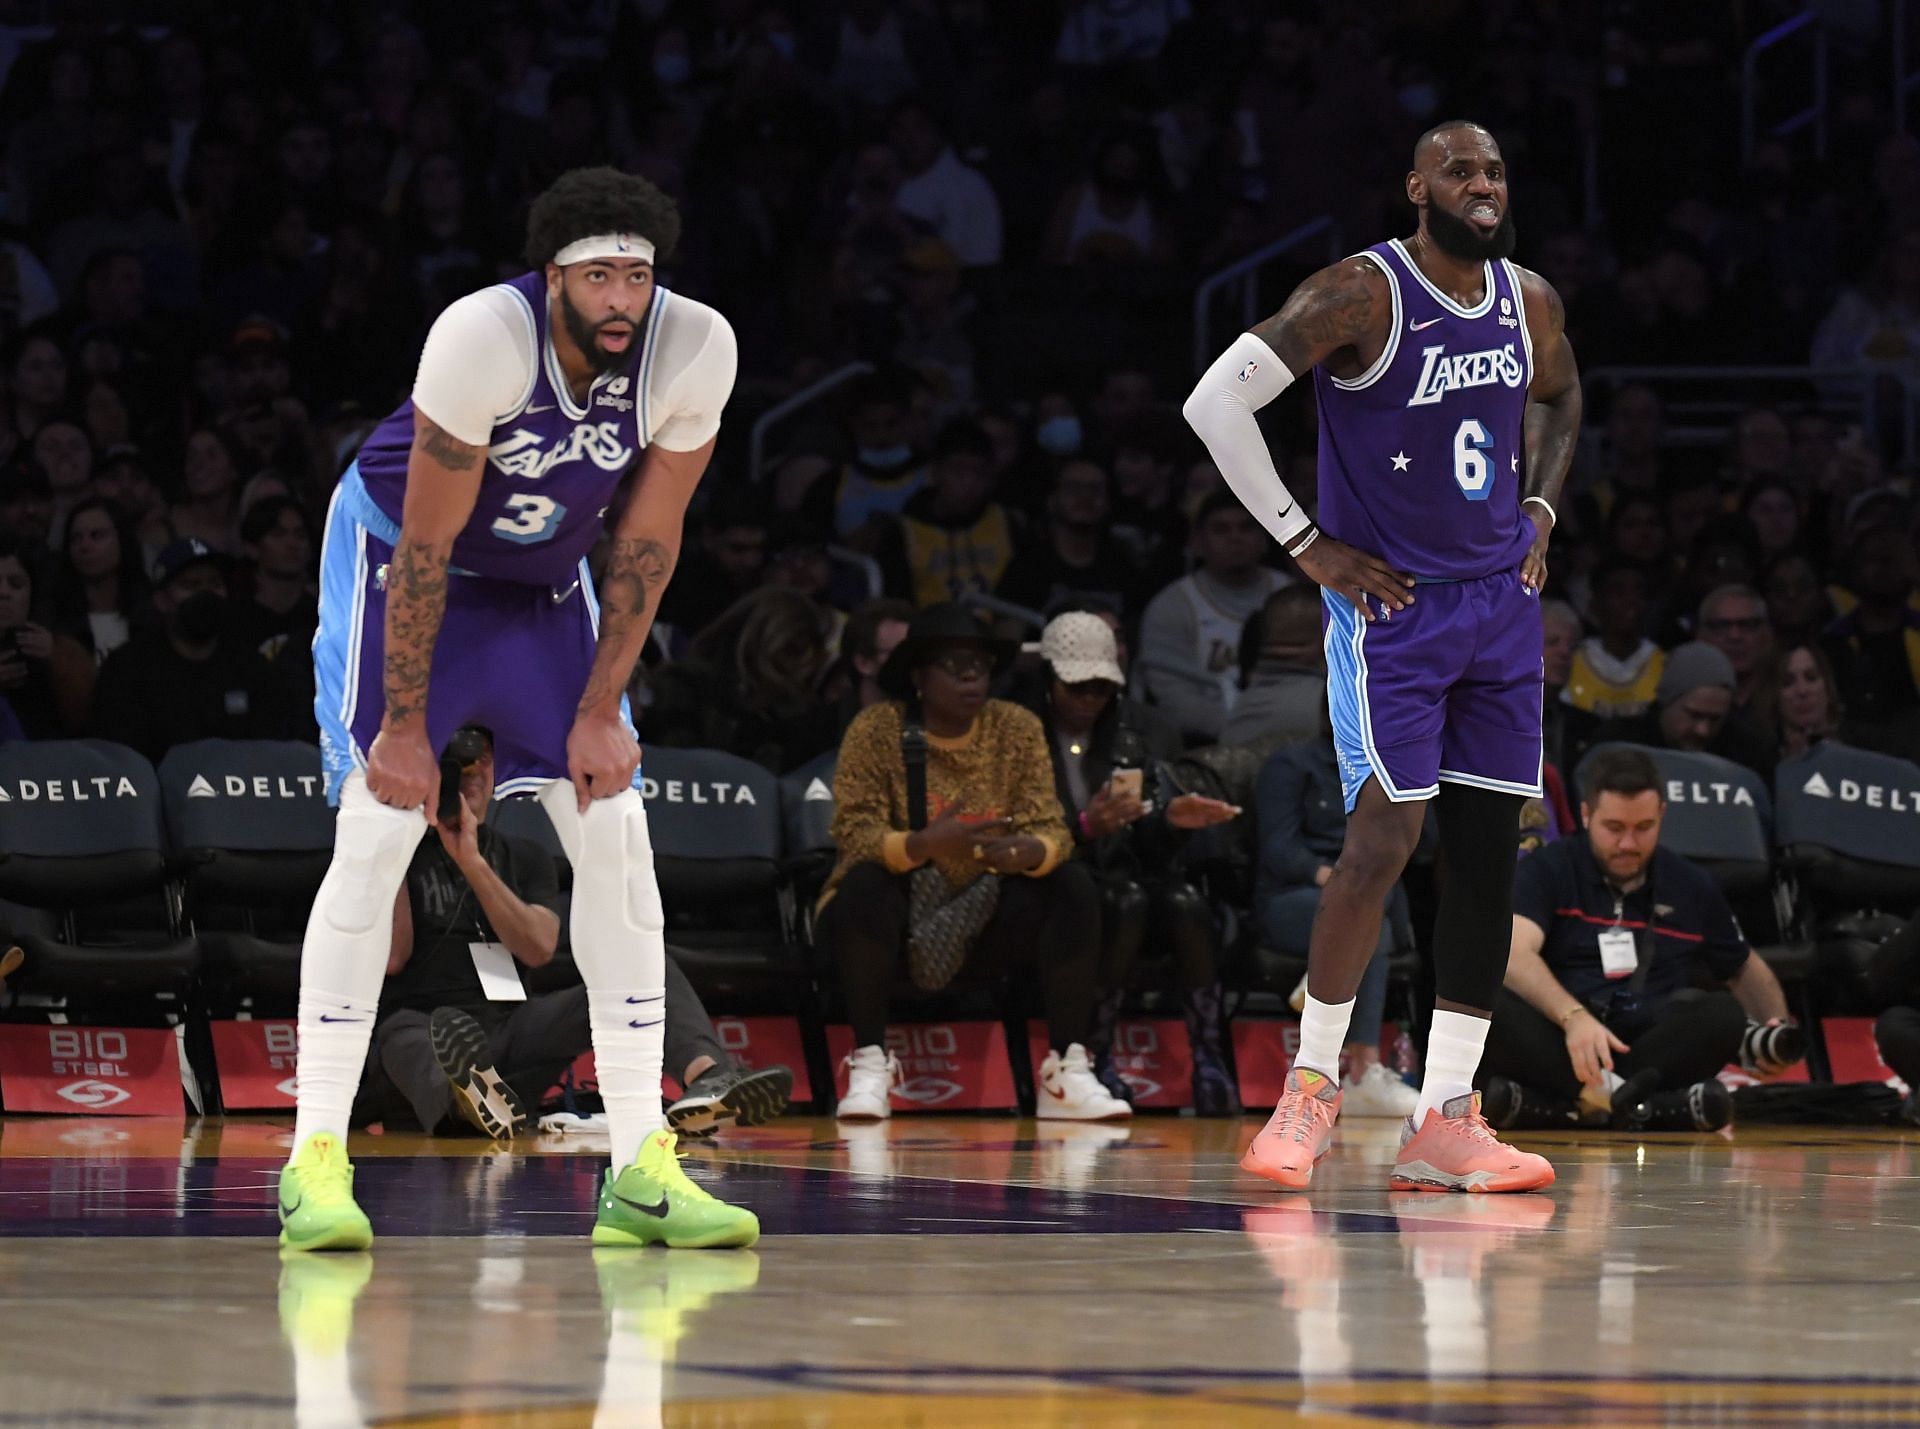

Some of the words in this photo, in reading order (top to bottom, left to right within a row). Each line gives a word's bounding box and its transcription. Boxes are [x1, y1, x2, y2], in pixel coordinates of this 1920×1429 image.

[1407, 342, 1523, 408] LAKERS
[1454, 419, 1496, 501] 6
[490, 493, 567, 544] 3
[19, 776, 138, 802] DELTA
[225, 775, 328, 798] DELT
[641, 777, 757, 806] DELTA
[1666, 780, 1755, 807] ELTA
[49, 1030, 128, 1060] BIO
[1113, 1024, 1158, 1054] IO
[52, 1061, 130, 1077] STEEL
